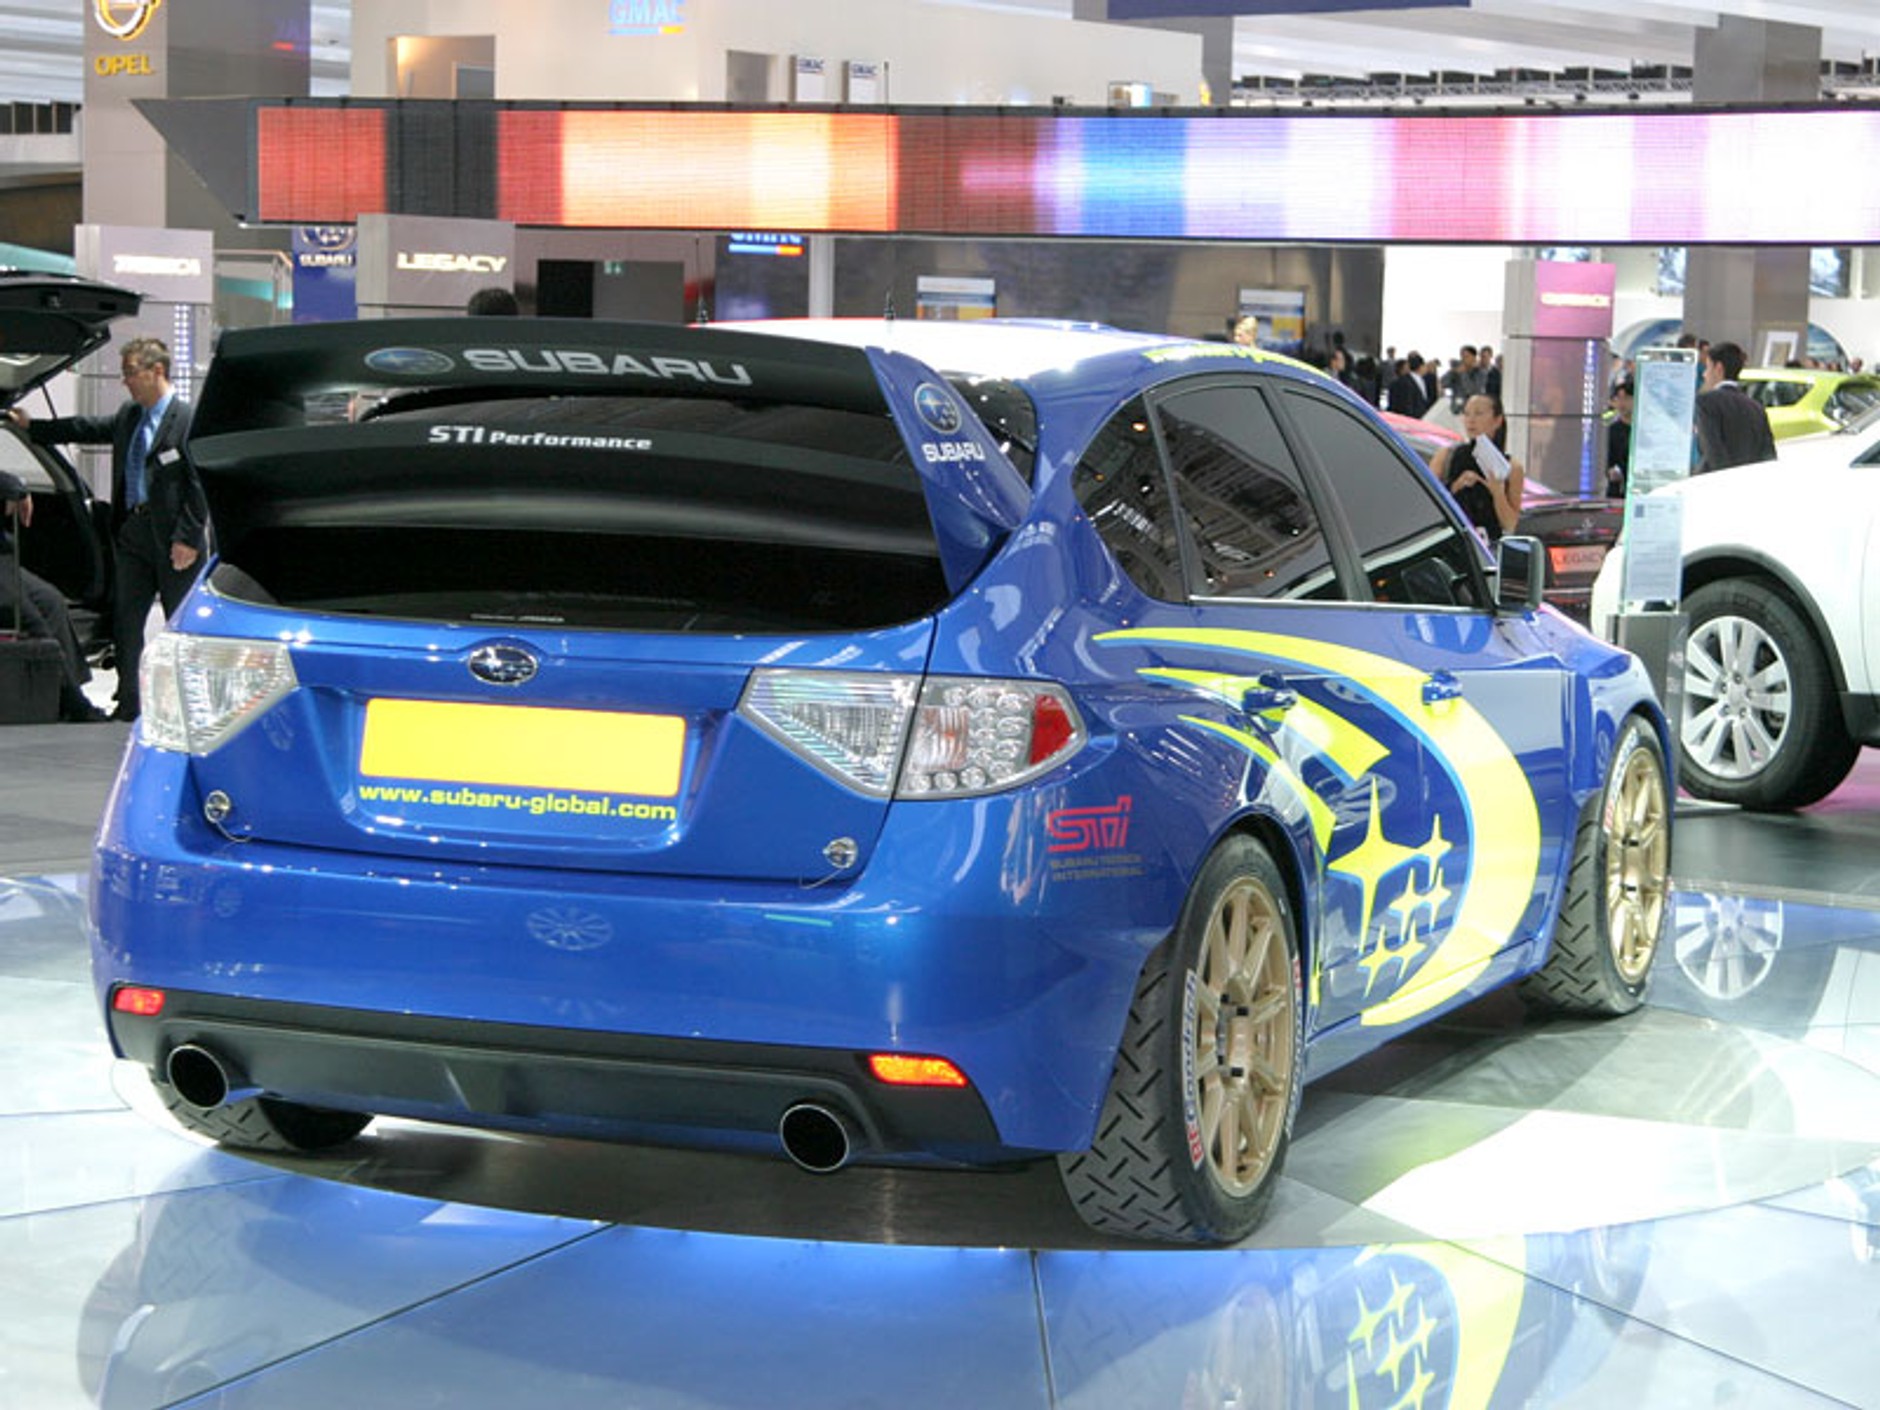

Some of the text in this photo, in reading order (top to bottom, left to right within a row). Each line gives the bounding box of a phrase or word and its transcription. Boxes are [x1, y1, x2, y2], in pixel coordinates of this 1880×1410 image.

[608, 0, 686, 23] GMAC
[95, 55, 153, 76] OPEL
[397, 252, 507, 272] LEGACY
[463, 348, 753, 386] SUBARU
[428, 425, 652, 451] STI Performance
[921, 441, 986, 462] SUBARU
[359, 784, 677, 821] www.subaru-global.com
